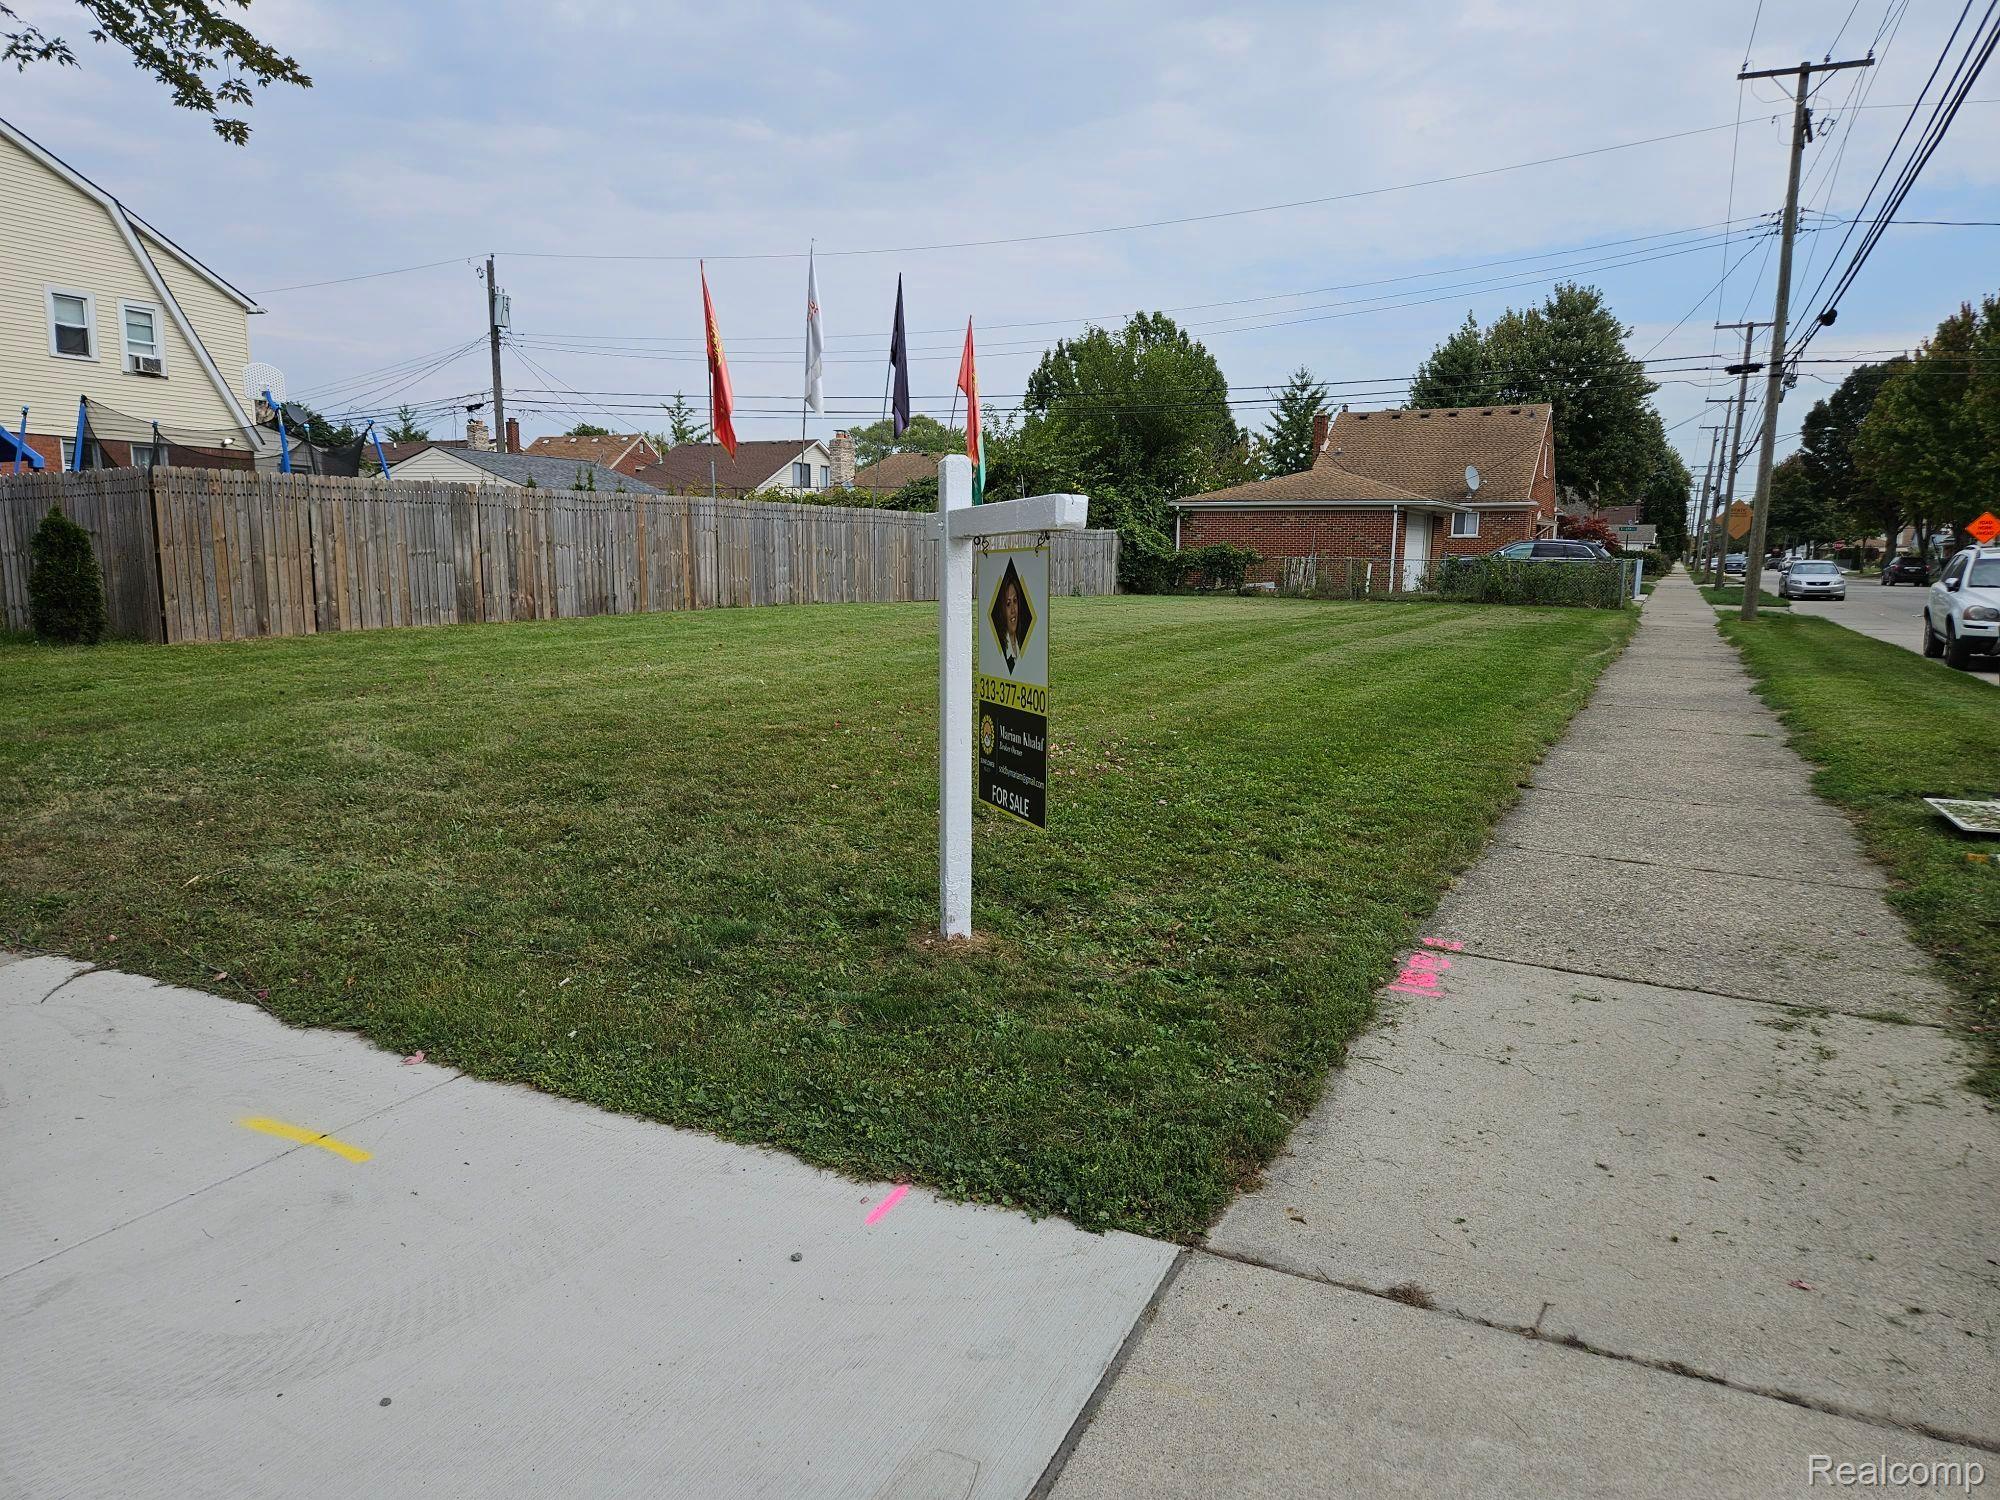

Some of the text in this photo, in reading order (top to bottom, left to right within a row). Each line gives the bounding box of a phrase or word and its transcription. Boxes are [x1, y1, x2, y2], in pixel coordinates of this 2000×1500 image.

[980, 678, 1045, 713] 313-377-8400
[992, 785, 1029, 817] FOR SALE
